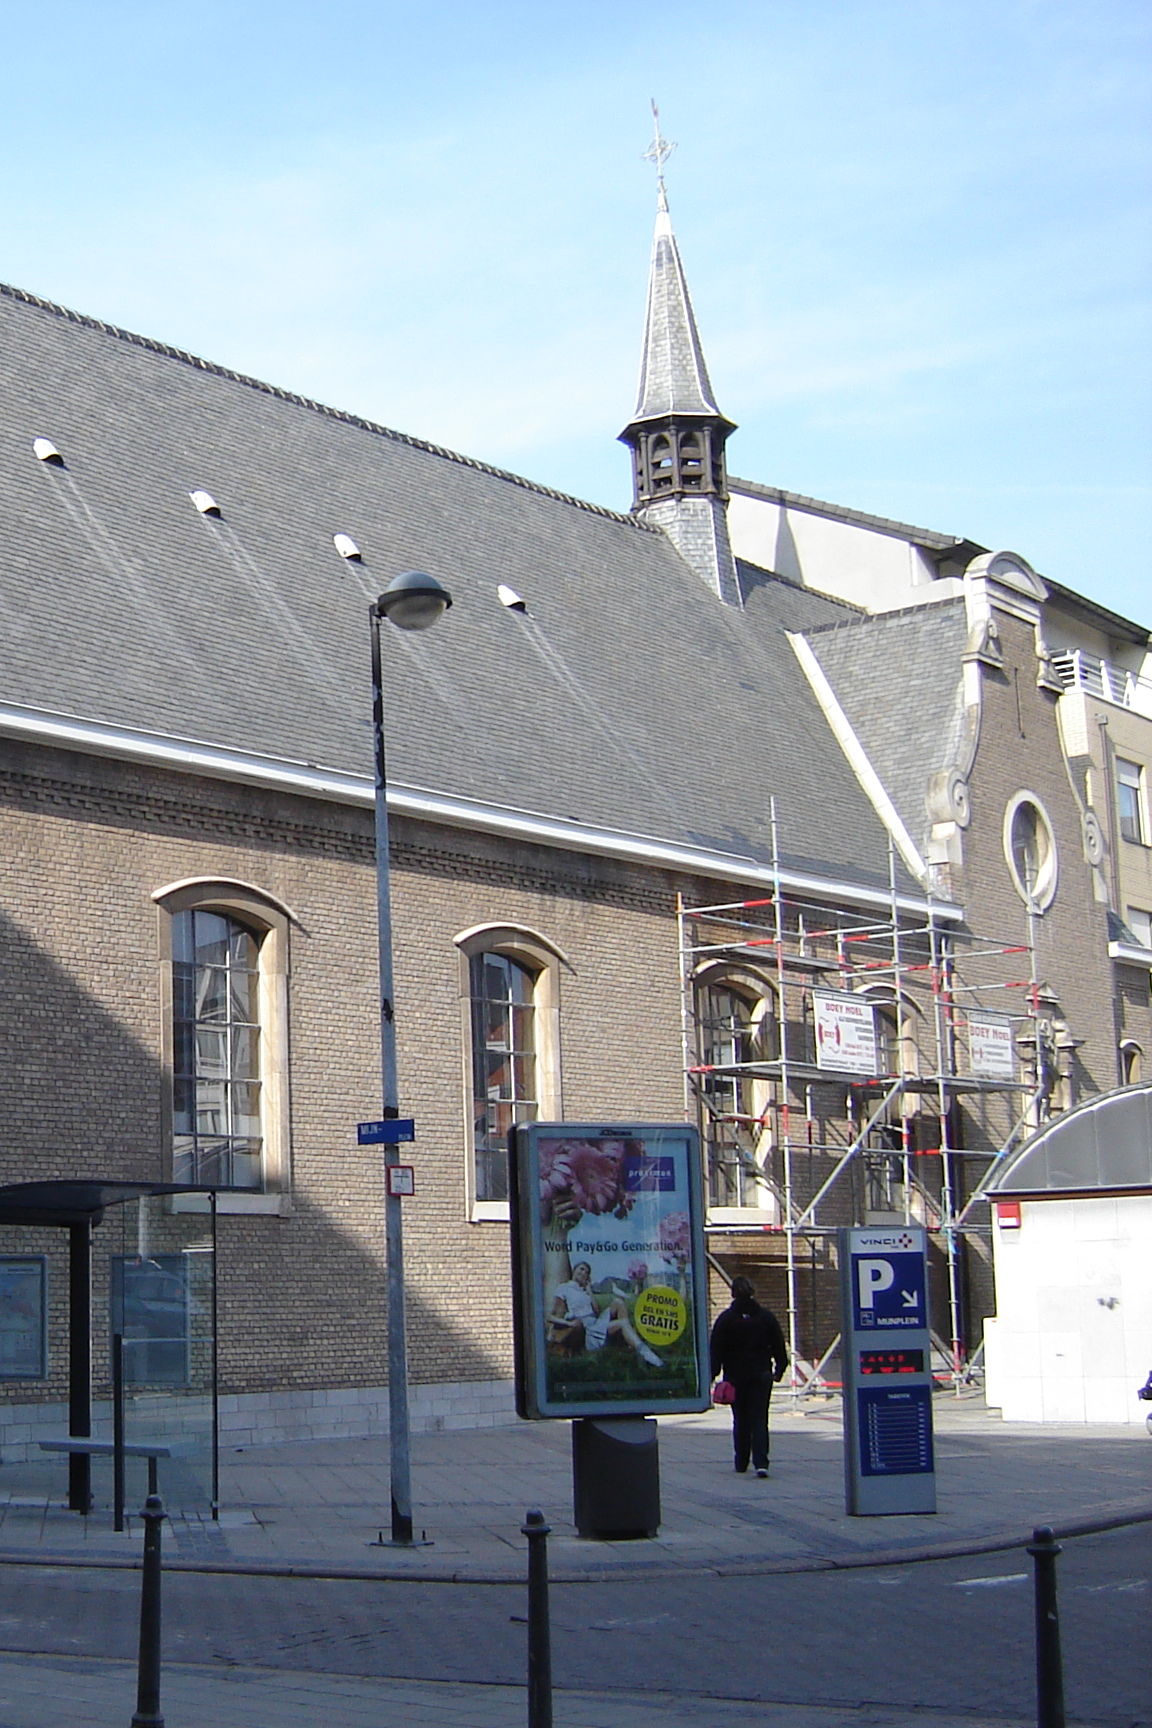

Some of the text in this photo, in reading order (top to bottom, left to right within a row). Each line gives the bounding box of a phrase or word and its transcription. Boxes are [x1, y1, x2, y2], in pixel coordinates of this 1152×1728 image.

[544, 1240, 684, 1254] Word Pay&Go Generation.
[858, 1259, 894, 1309] P
[647, 1293, 678, 1307] PROMO
[640, 1313, 680, 1331] GRATIS
